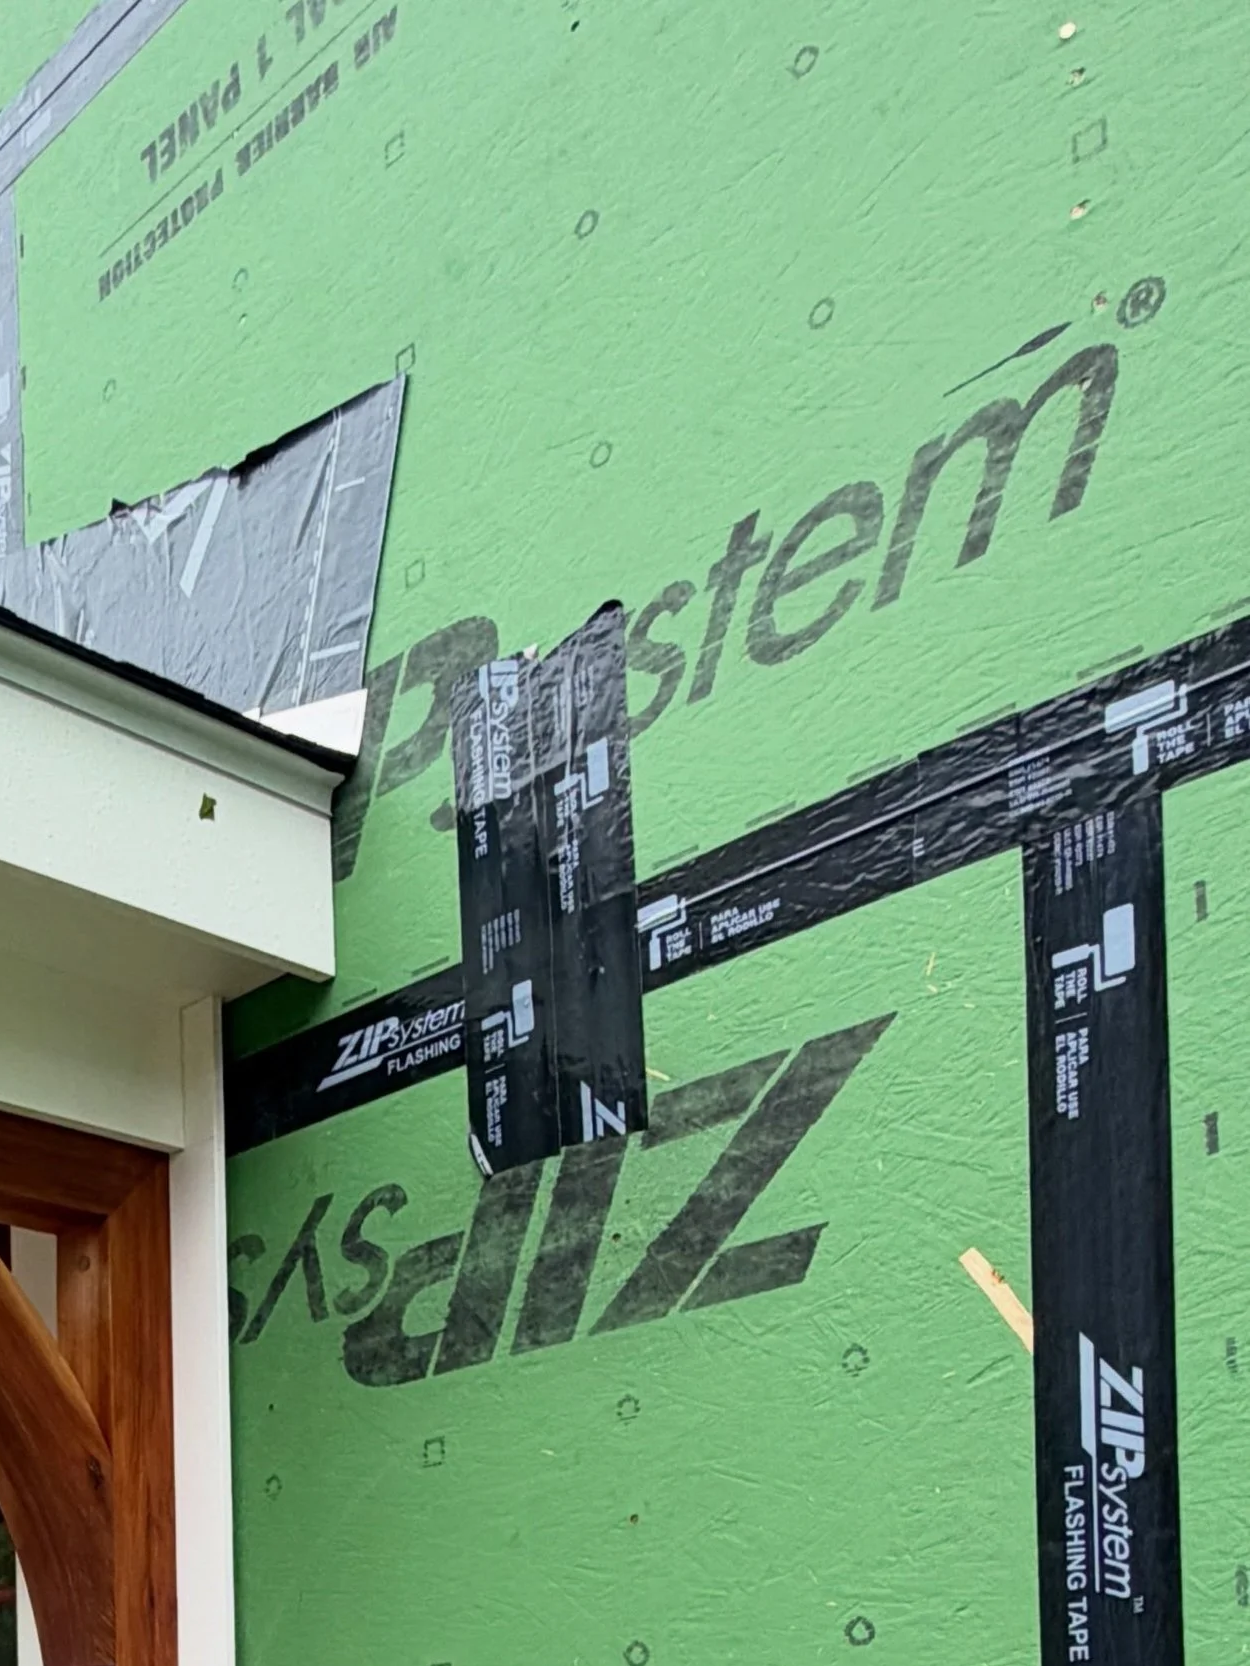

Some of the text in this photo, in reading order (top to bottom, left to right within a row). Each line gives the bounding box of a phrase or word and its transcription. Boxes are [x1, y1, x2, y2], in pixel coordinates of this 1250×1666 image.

[141, 61, 242, 184] PANEL
[473, 808, 489, 860] TAPE
[1054, 974, 1066, 1010] TAPE
[1065, 970, 1076, 998] THE
[1076, 967, 1088, 1004] ROLL
[387, 1033, 461, 1076] FLASHING
[1066, 1032, 1079, 1092] APLICAR
[1078, 1027, 1090, 1065] PARA
[1055, 1034, 1067, 1114] EL RODILLO
[1099, 1357, 1146, 1600] ZIPsystem
[1063, 1464, 1090, 1663] FLASHING TAPE
